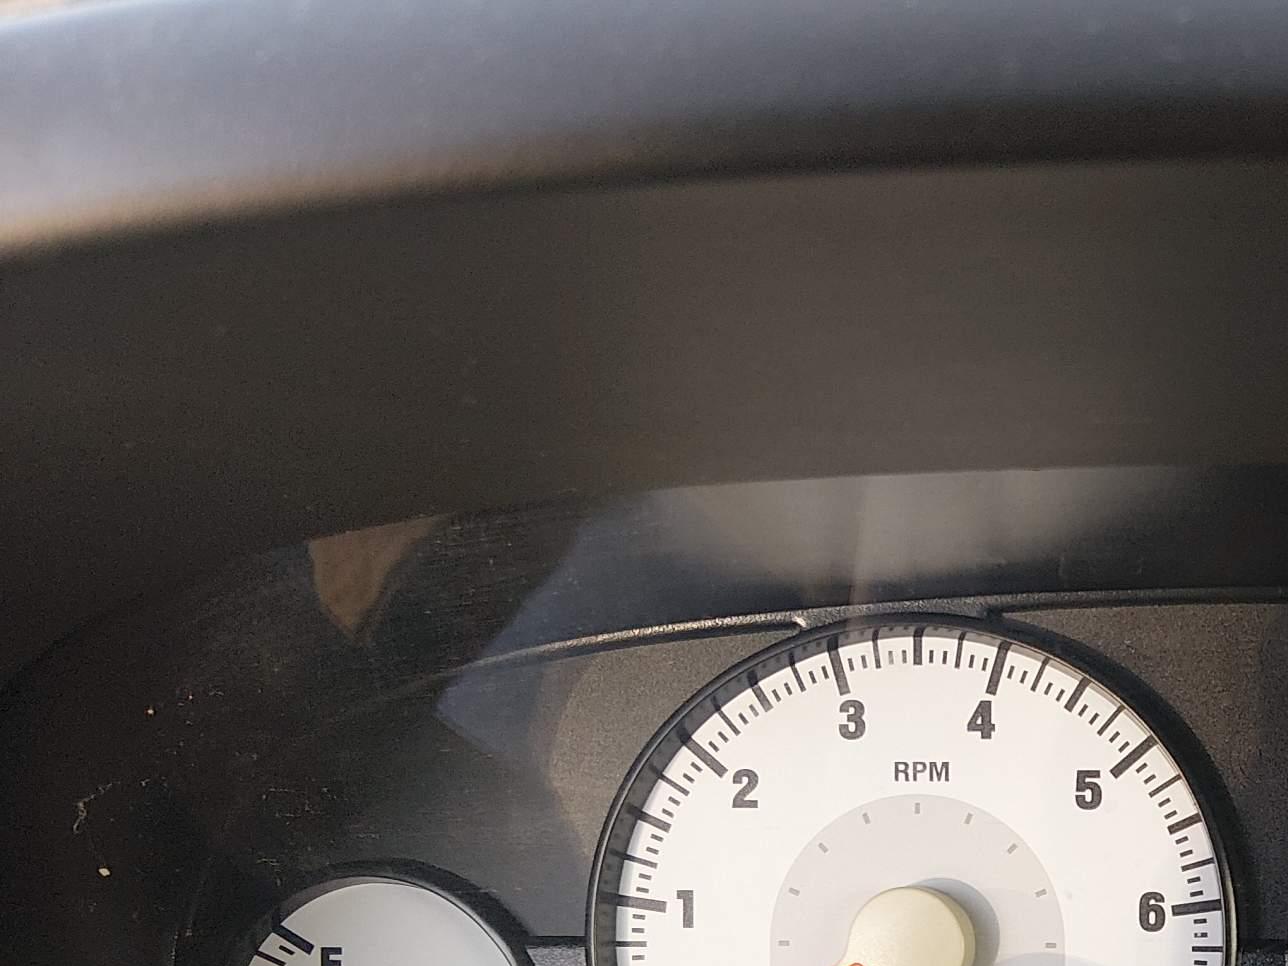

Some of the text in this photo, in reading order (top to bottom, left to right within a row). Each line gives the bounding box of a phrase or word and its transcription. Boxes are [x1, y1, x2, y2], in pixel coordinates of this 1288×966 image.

[838, 699, 866, 740] 3
[966, 699, 996, 740] 4
[731, 768, 759, 809] 2
[893, 761, 950, 783] RPM
[1074, 769, 1103, 811] 5
[676, 889, 694, 929] 1
[1138, 891, 1166, 933] 6
